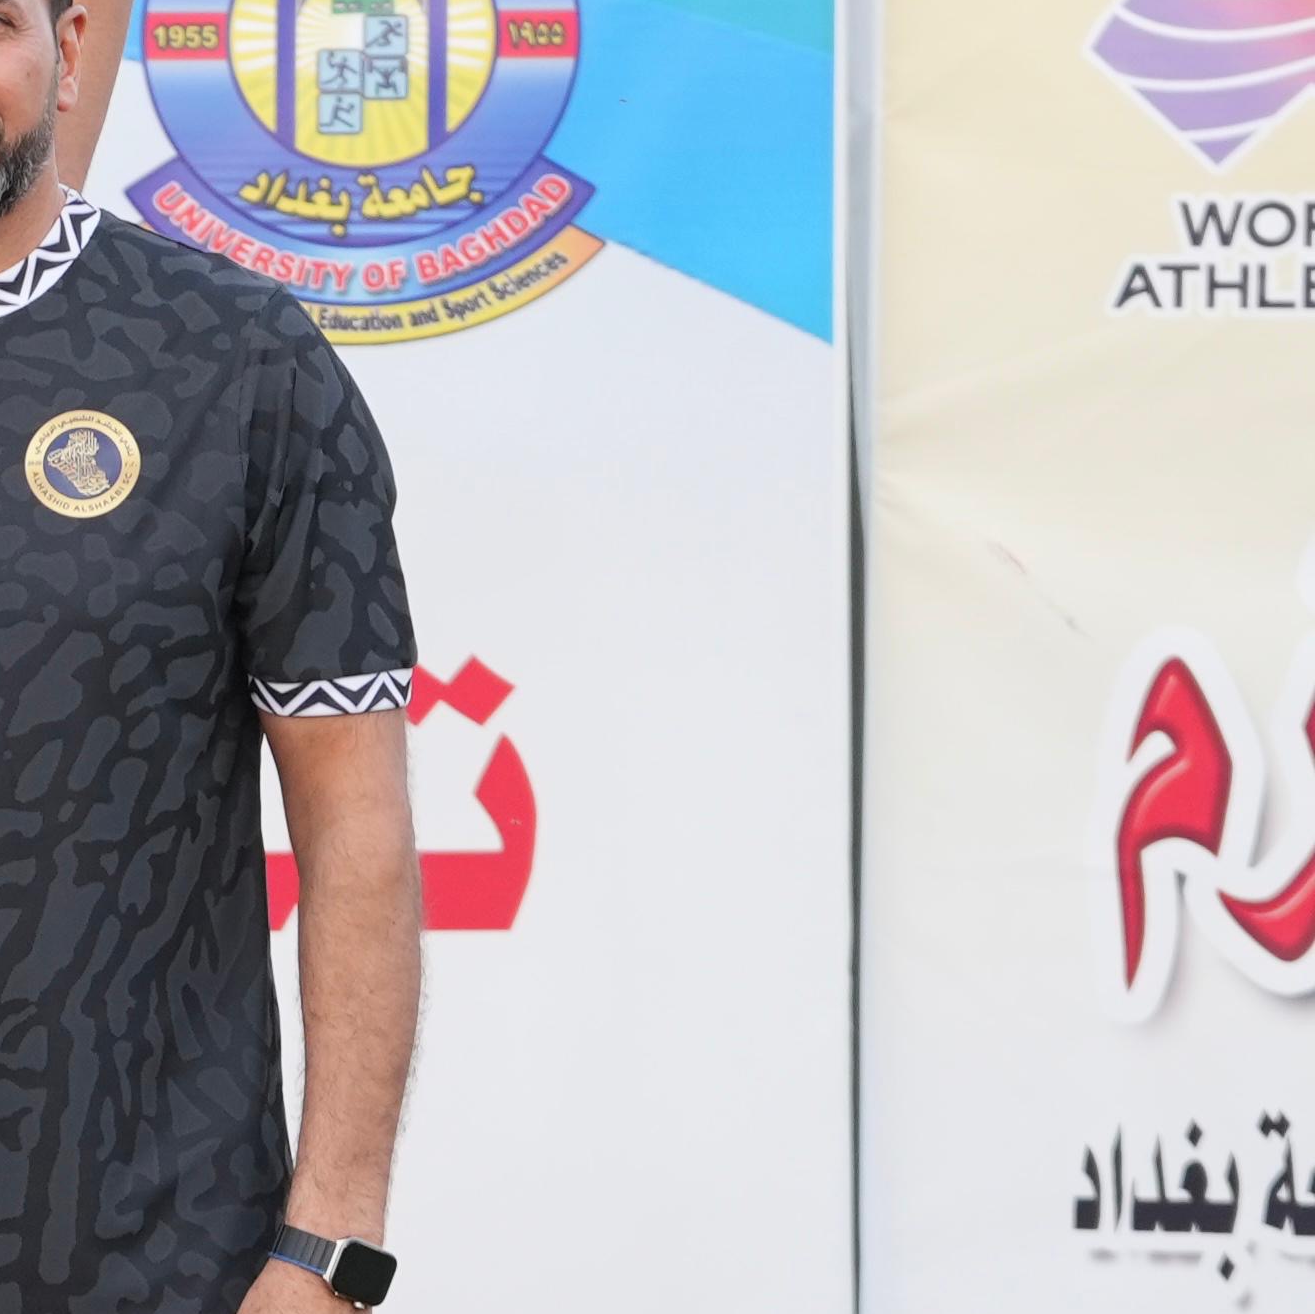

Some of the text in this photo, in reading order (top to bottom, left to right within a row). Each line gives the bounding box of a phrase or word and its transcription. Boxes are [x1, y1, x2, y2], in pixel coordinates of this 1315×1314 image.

[152, 22, 220, 50] 1955
[507, 21, 565, 48] ١٩٥٥
[154, 174, 572, 291] UNIVERSITY OF BAGHDAD
[239, 165, 485, 237] جامعة بغداد
[318, 307, 404, 331] Education
[408, 301, 440, 327] and
[442, 291, 492, 321] Sport
[490, 251, 569, 300] Sciences
[33, 471, 70, 510] ALHASHID
[73, 486, 125, 513] ALSHAABI
[1073, 1118, 1240, 1282] بغداد
